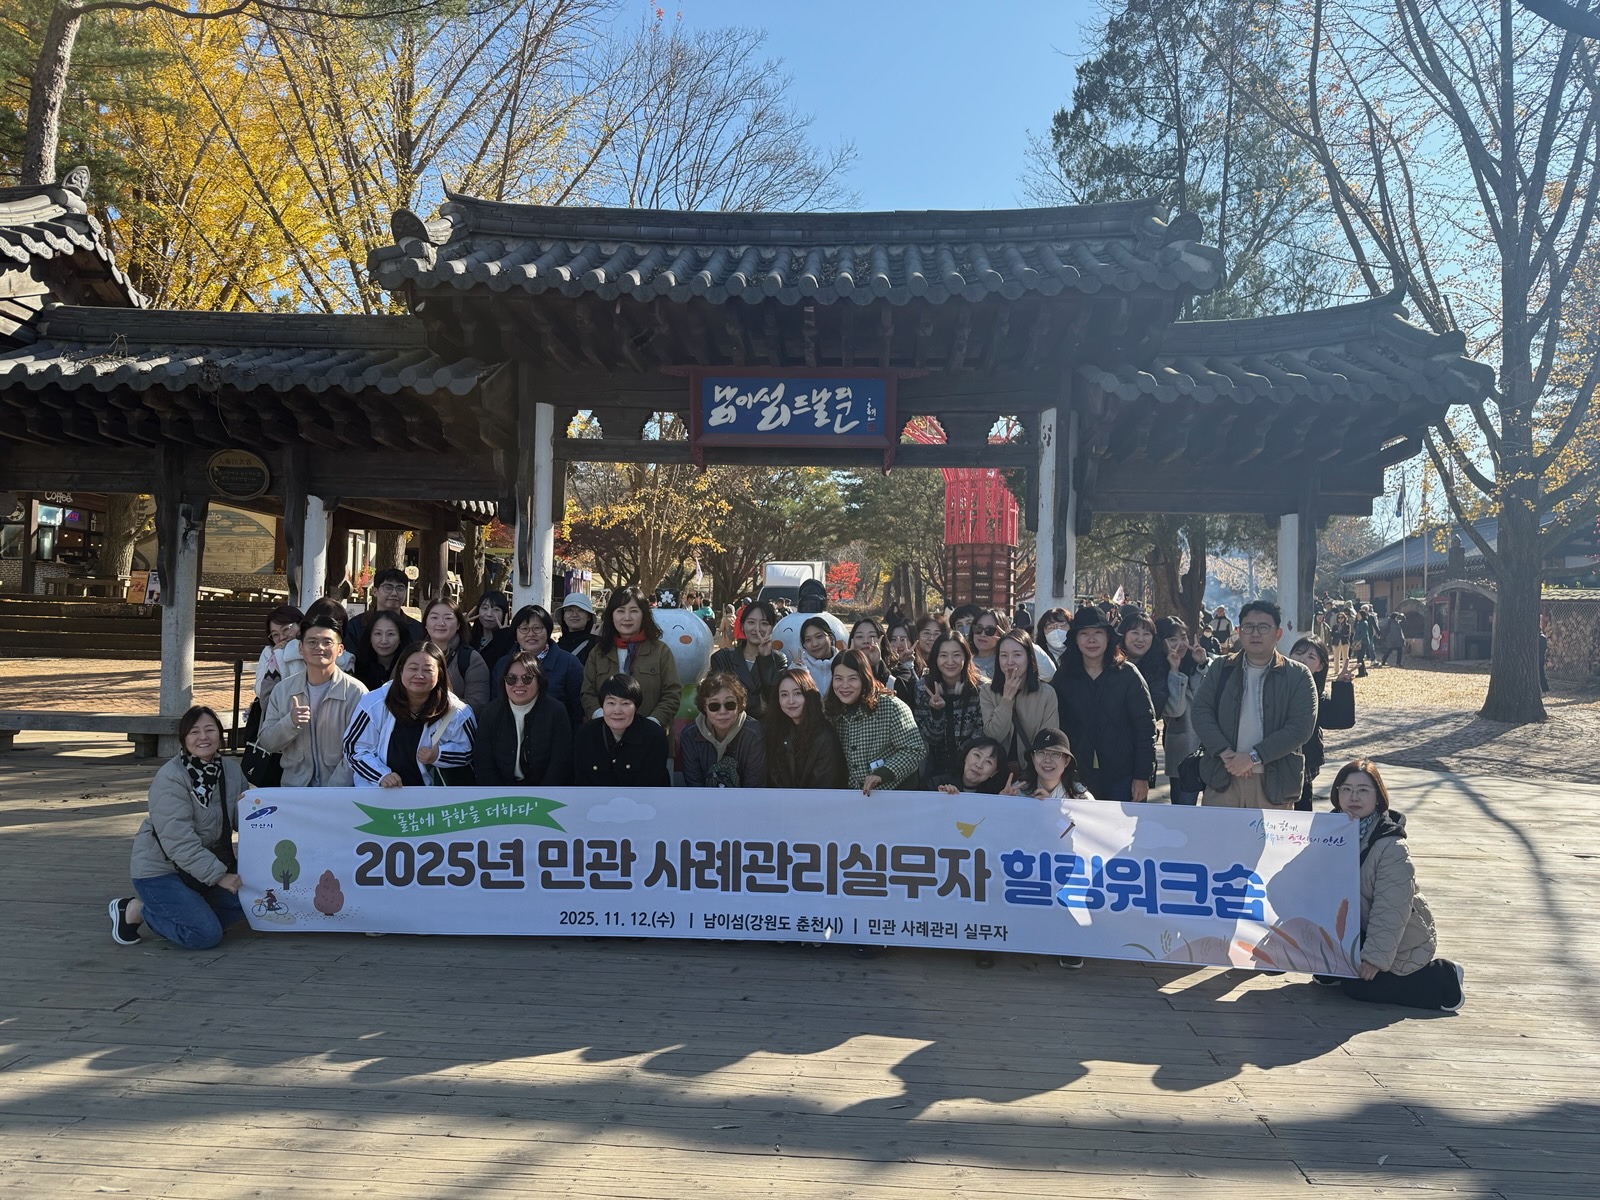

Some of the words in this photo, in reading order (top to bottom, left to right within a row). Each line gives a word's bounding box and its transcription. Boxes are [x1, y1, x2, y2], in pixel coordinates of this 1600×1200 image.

[441, 805, 480, 828] 무한을
[1322, 836, 1347, 847] 안산
[354, 838, 525, 890] 2025년
[538, 838, 637, 890] 민관
[643, 838, 992, 902] 사례관리실무자
[1000, 849, 1267, 922] 힐링워크숍
[559, 911, 599, 926] 2025.
[604, 911, 625, 926] 11.
[630, 911, 675, 929] 12.(수)
[703, 912, 792, 931] 남이섬(강원도
[796, 916, 844, 934] 춘천시)
[868, 918, 896, 936] 민관
[900, 920, 958, 939] 사례관리
[963, 923, 1009, 942] 실무자
